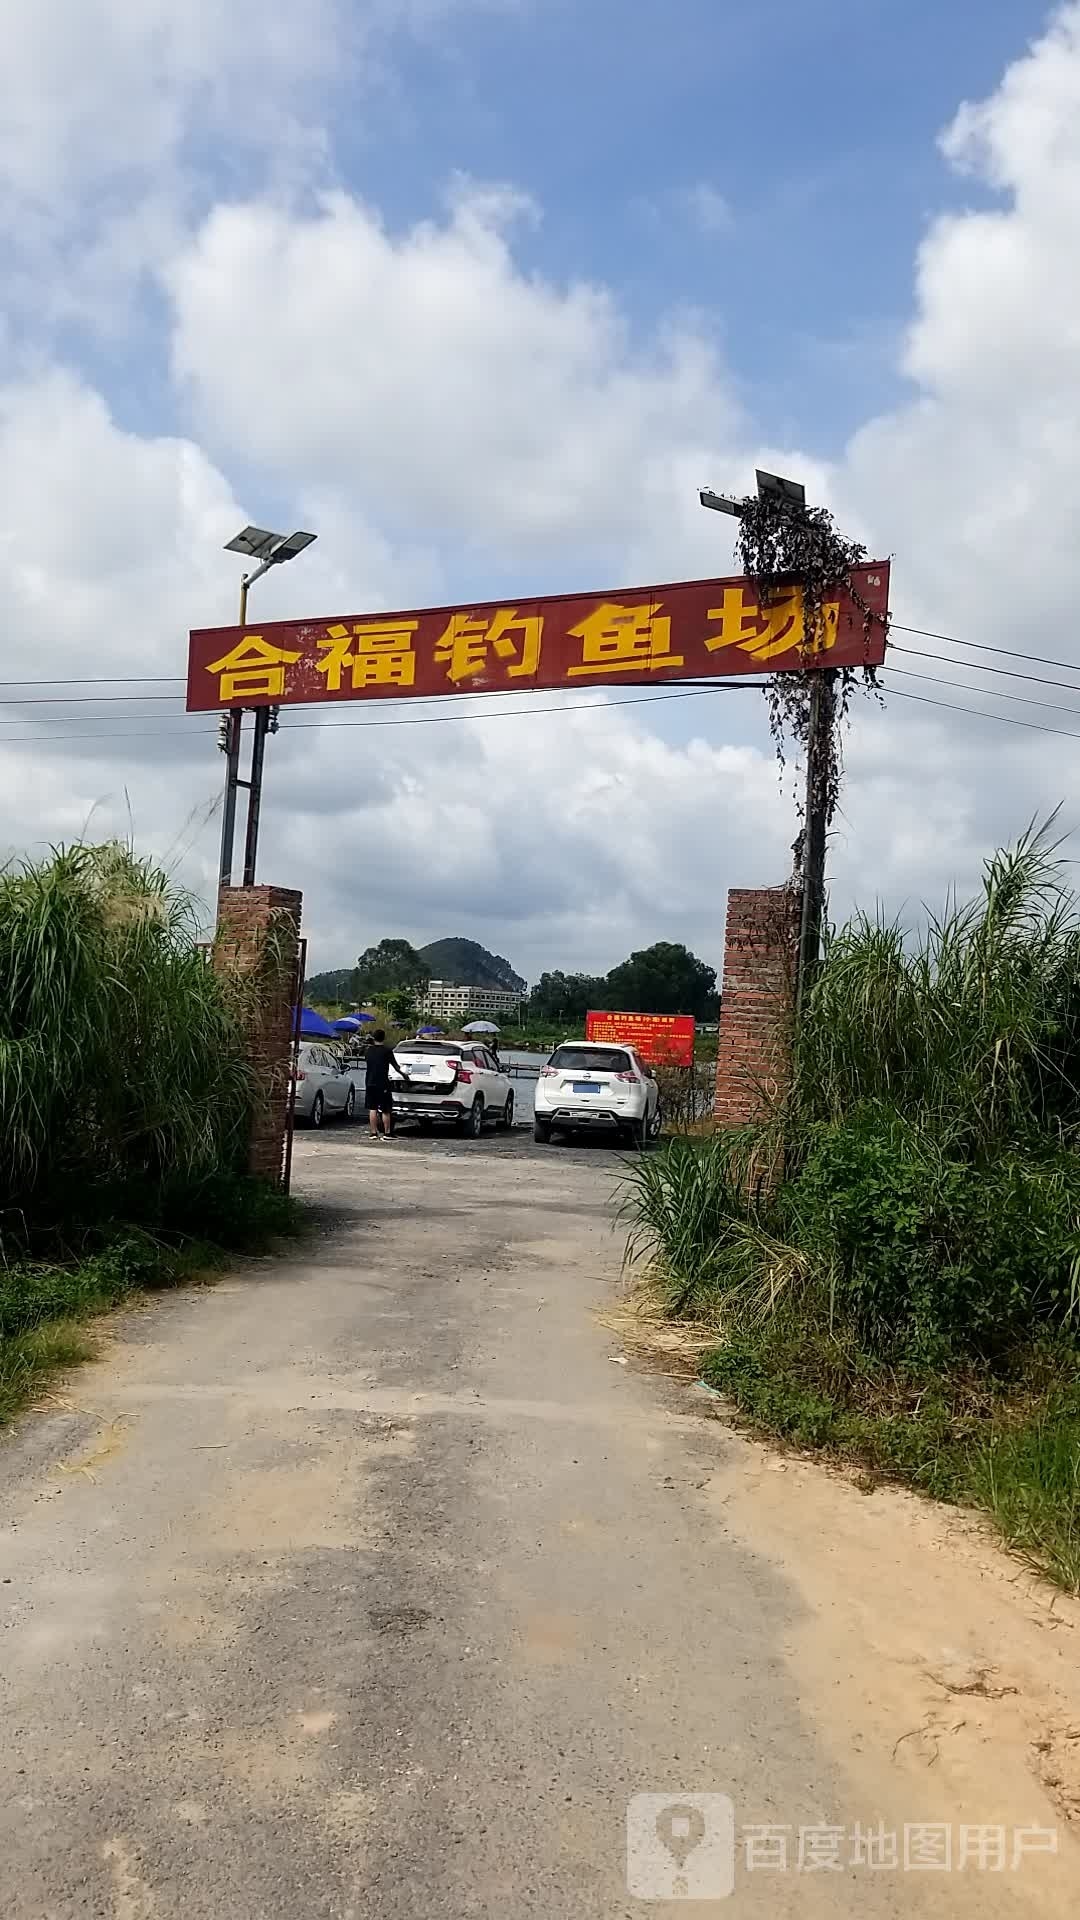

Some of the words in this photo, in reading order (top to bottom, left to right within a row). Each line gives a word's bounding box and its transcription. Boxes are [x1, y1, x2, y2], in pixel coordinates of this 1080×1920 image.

[206, 585, 840, 701] 合福钓鱼场
